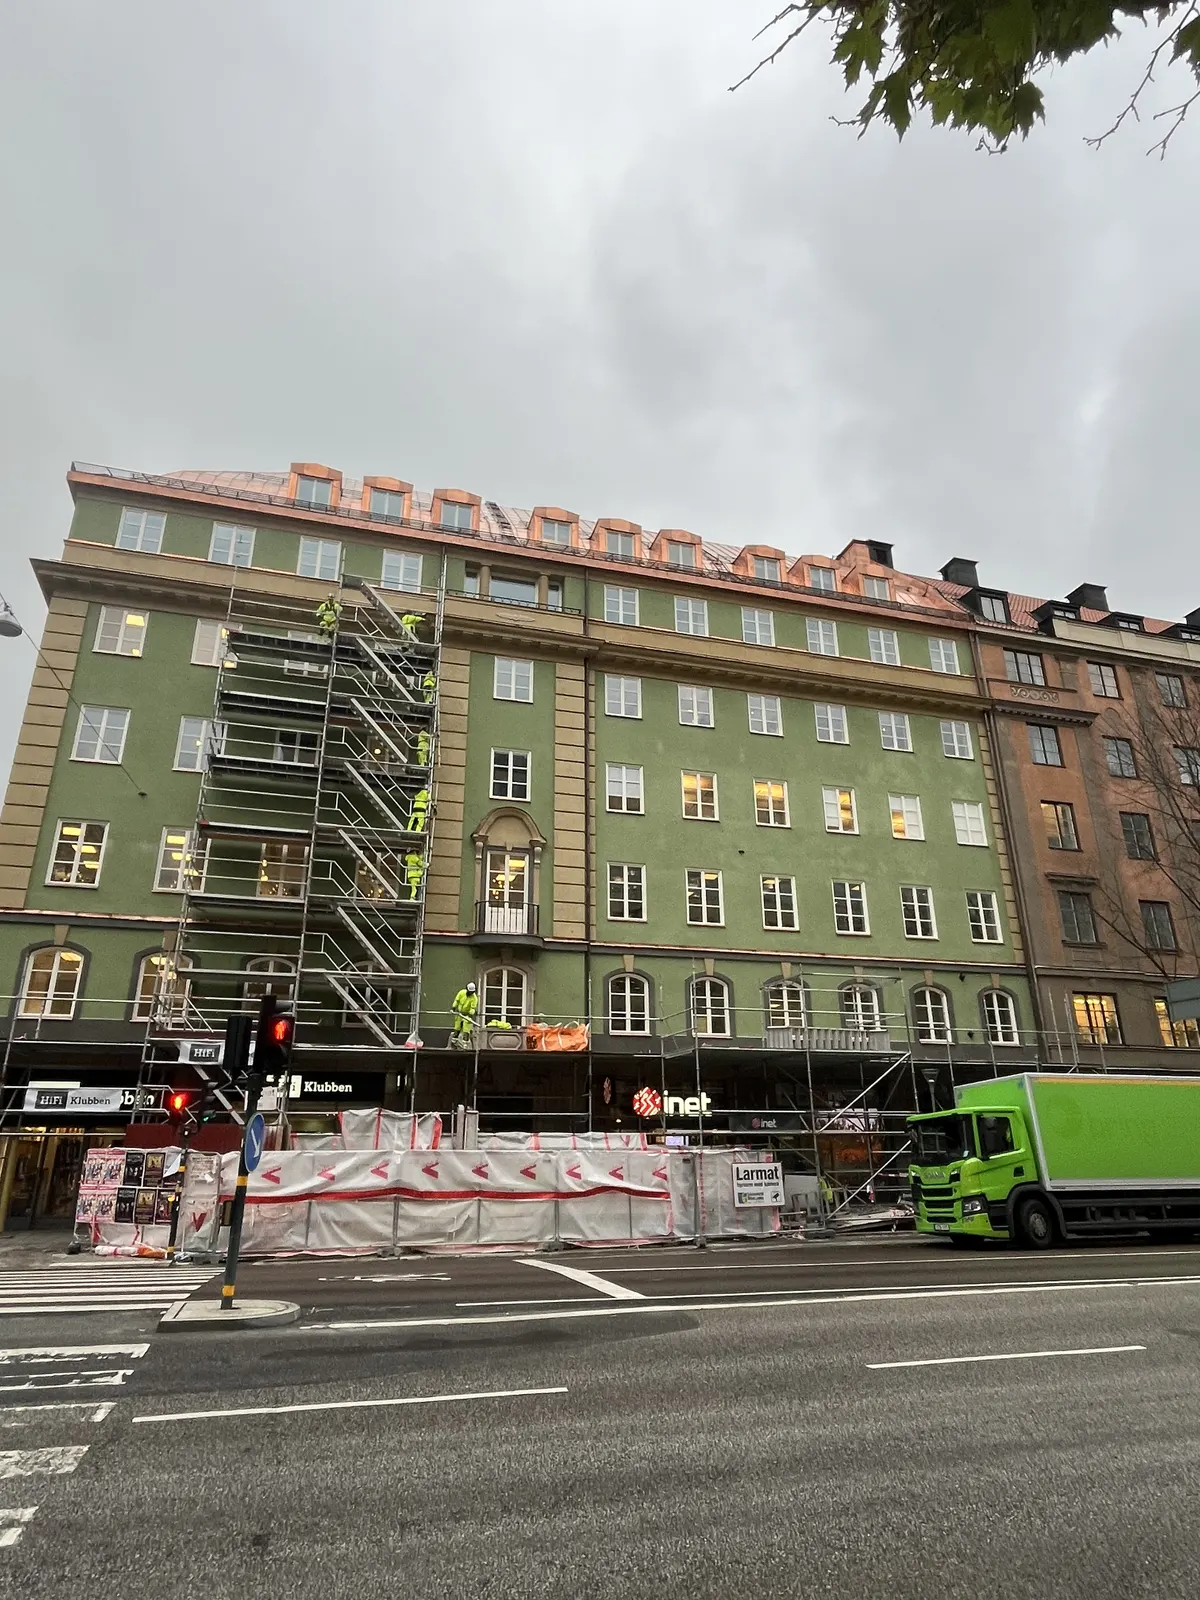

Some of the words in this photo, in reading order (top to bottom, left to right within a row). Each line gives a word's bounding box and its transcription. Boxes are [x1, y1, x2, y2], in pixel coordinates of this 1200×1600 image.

[193, 1048, 215, 1058] HiFi
[303, 1081, 353, 1092] Klubben
[39, 1095, 63, 1105] HiFi
[70, 1096, 111, 1105] Klubben
[663, 1090, 713, 1116] inet
[760, 1118, 777, 1128] inet
[736, 1166, 779, 1180] Larmat
